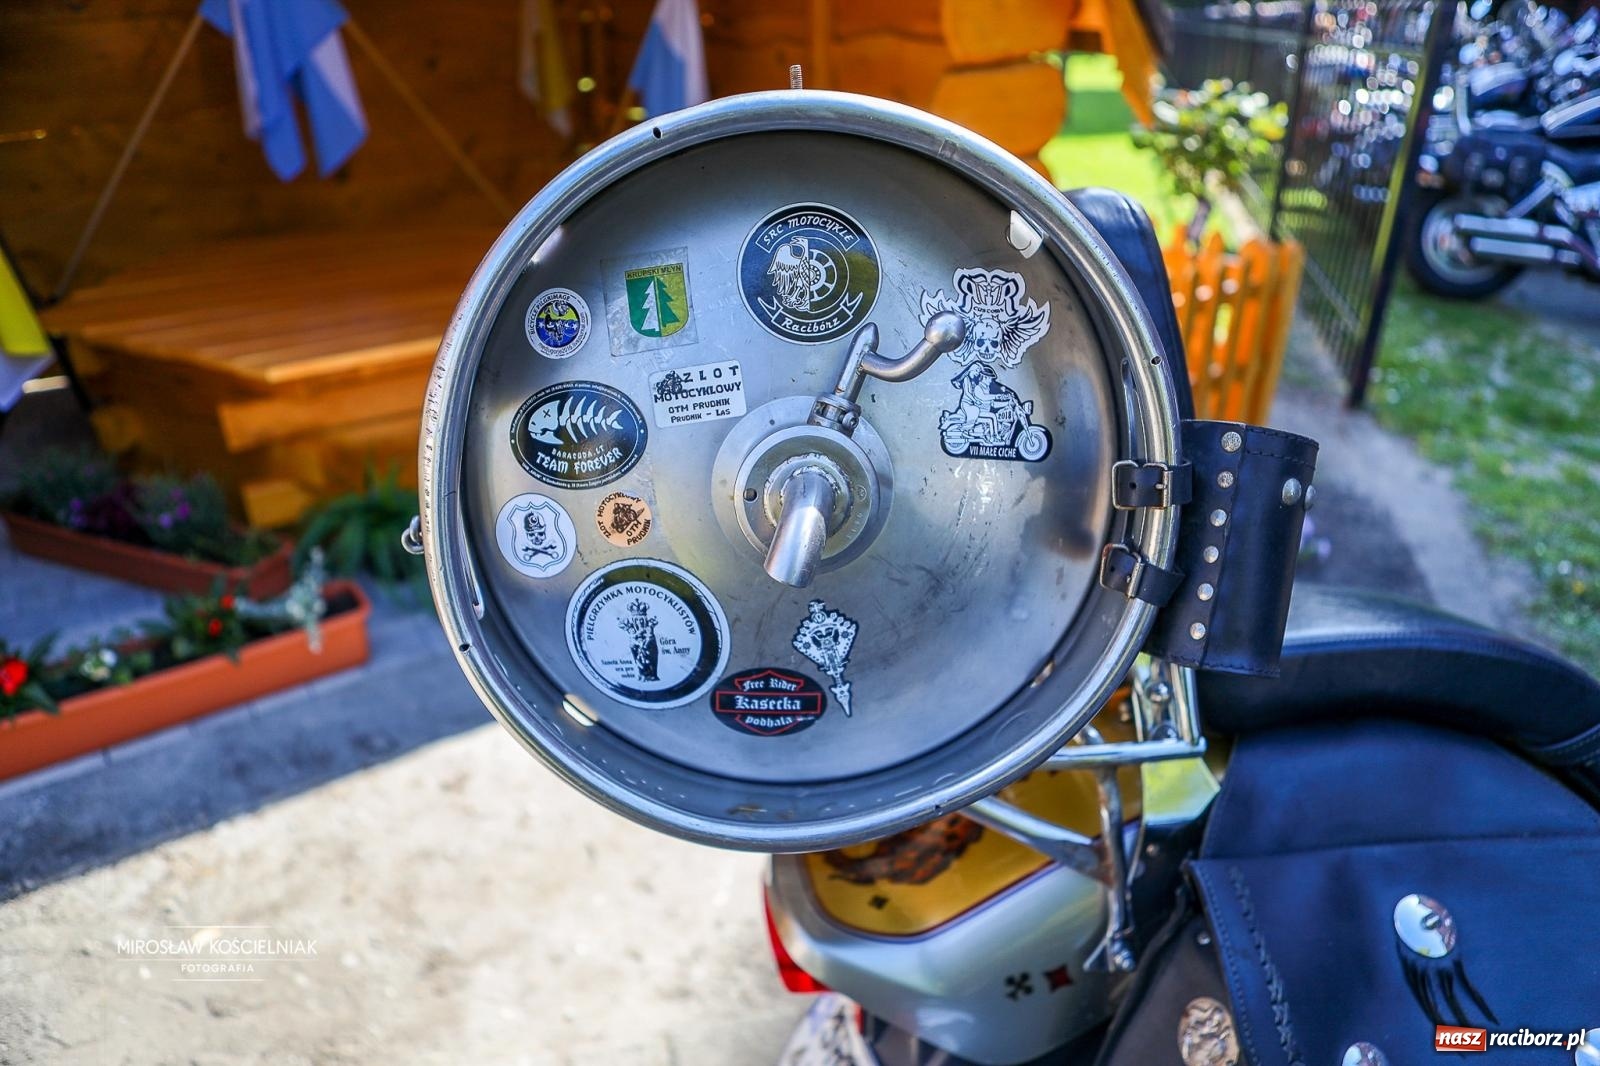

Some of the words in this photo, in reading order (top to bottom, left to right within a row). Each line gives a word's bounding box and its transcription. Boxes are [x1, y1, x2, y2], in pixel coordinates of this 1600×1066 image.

[763, 224, 784, 246] SRC
[788, 215, 854, 243] MOTOCYKLE
[536, 294, 571, 311] PILGRIMAGE
[781, 317, 841, 332] Racibórz
[653, 381, 741, 403] MOTOCYKLOWY
[668, 404, 689, 414] OTM
[692, 398, 731, 411] PRUDNIK
[998, 410, 1011, 420] 2018
[998, 447, 1017, 458] CICHE
[536, 451, 569, 474] TEAM
[574, 447, 623, 475] FOREVER
[626, 519, 642, 533] OTM
[626, 519, 651, 546] PRUDNIK
[586, 588, 624, 641] PIELGRZYMKA
[625, 586, 696, 636] MOTOCYKLISTÓW
[659, 636, 677, 646] Góra
[673, 646, 690, 656] Anny
[742, 680, 764, 692] Free
[769, 678, 797, 691] Rider
